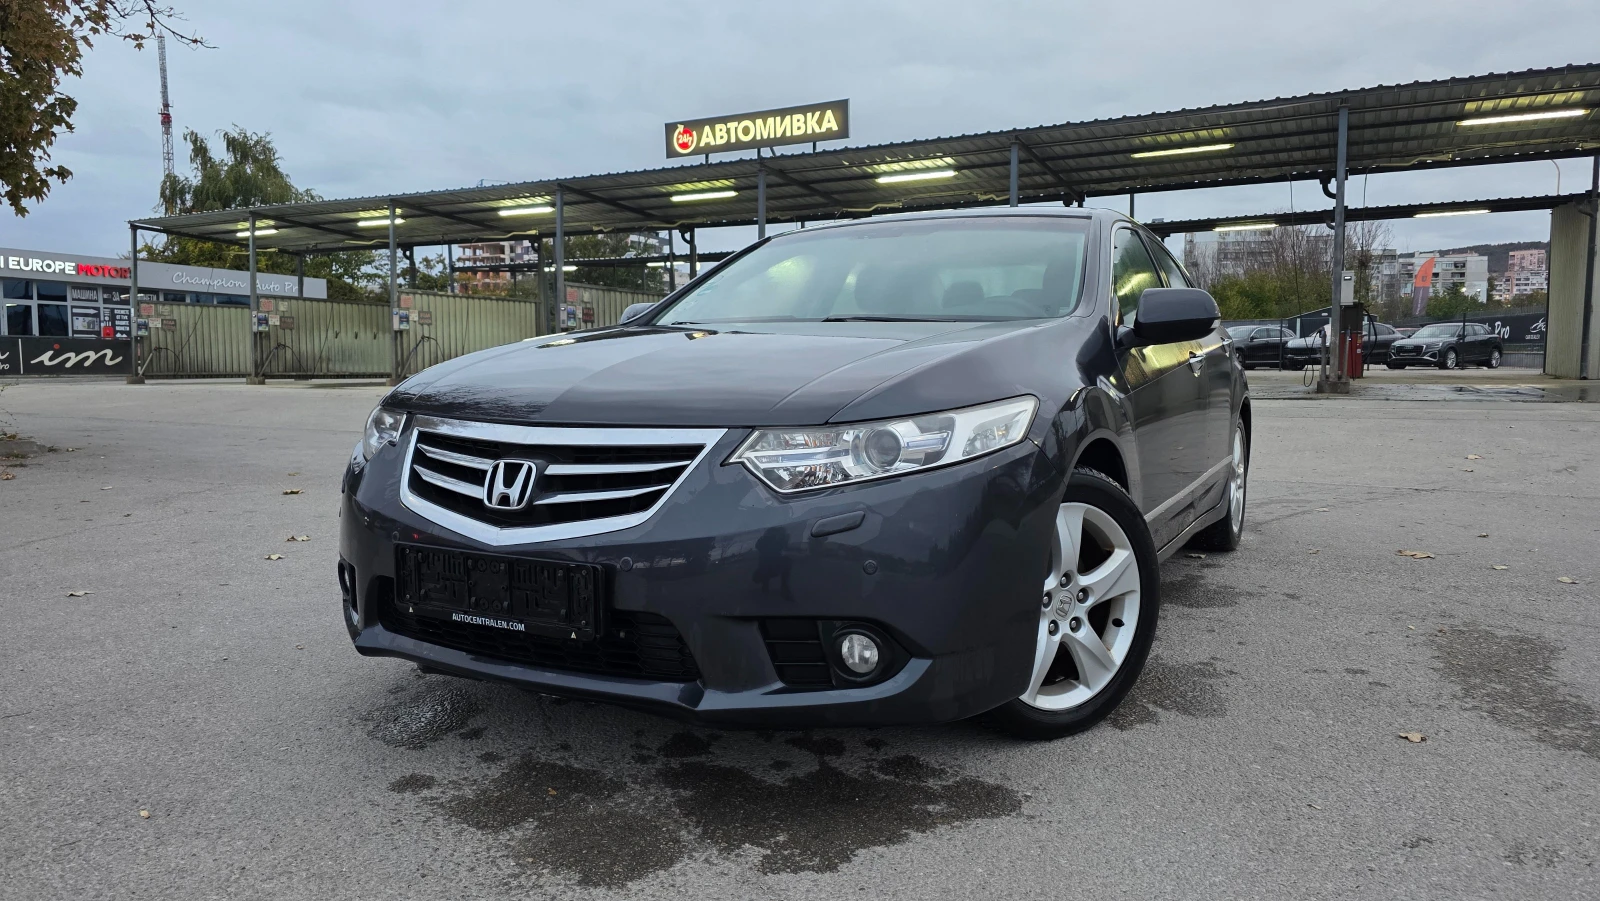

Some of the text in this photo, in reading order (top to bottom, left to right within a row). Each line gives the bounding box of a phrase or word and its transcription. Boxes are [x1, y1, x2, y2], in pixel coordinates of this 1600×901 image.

[699, 109, 838, 147] АВТОМИВКА
[8, 256, 76, 275] EUROPE
[172, 271, 247, 290] Champion
[284, 282, 298, 293] Pr
[452, 613, 525, 632] AUTOCENTRALEN.COM
